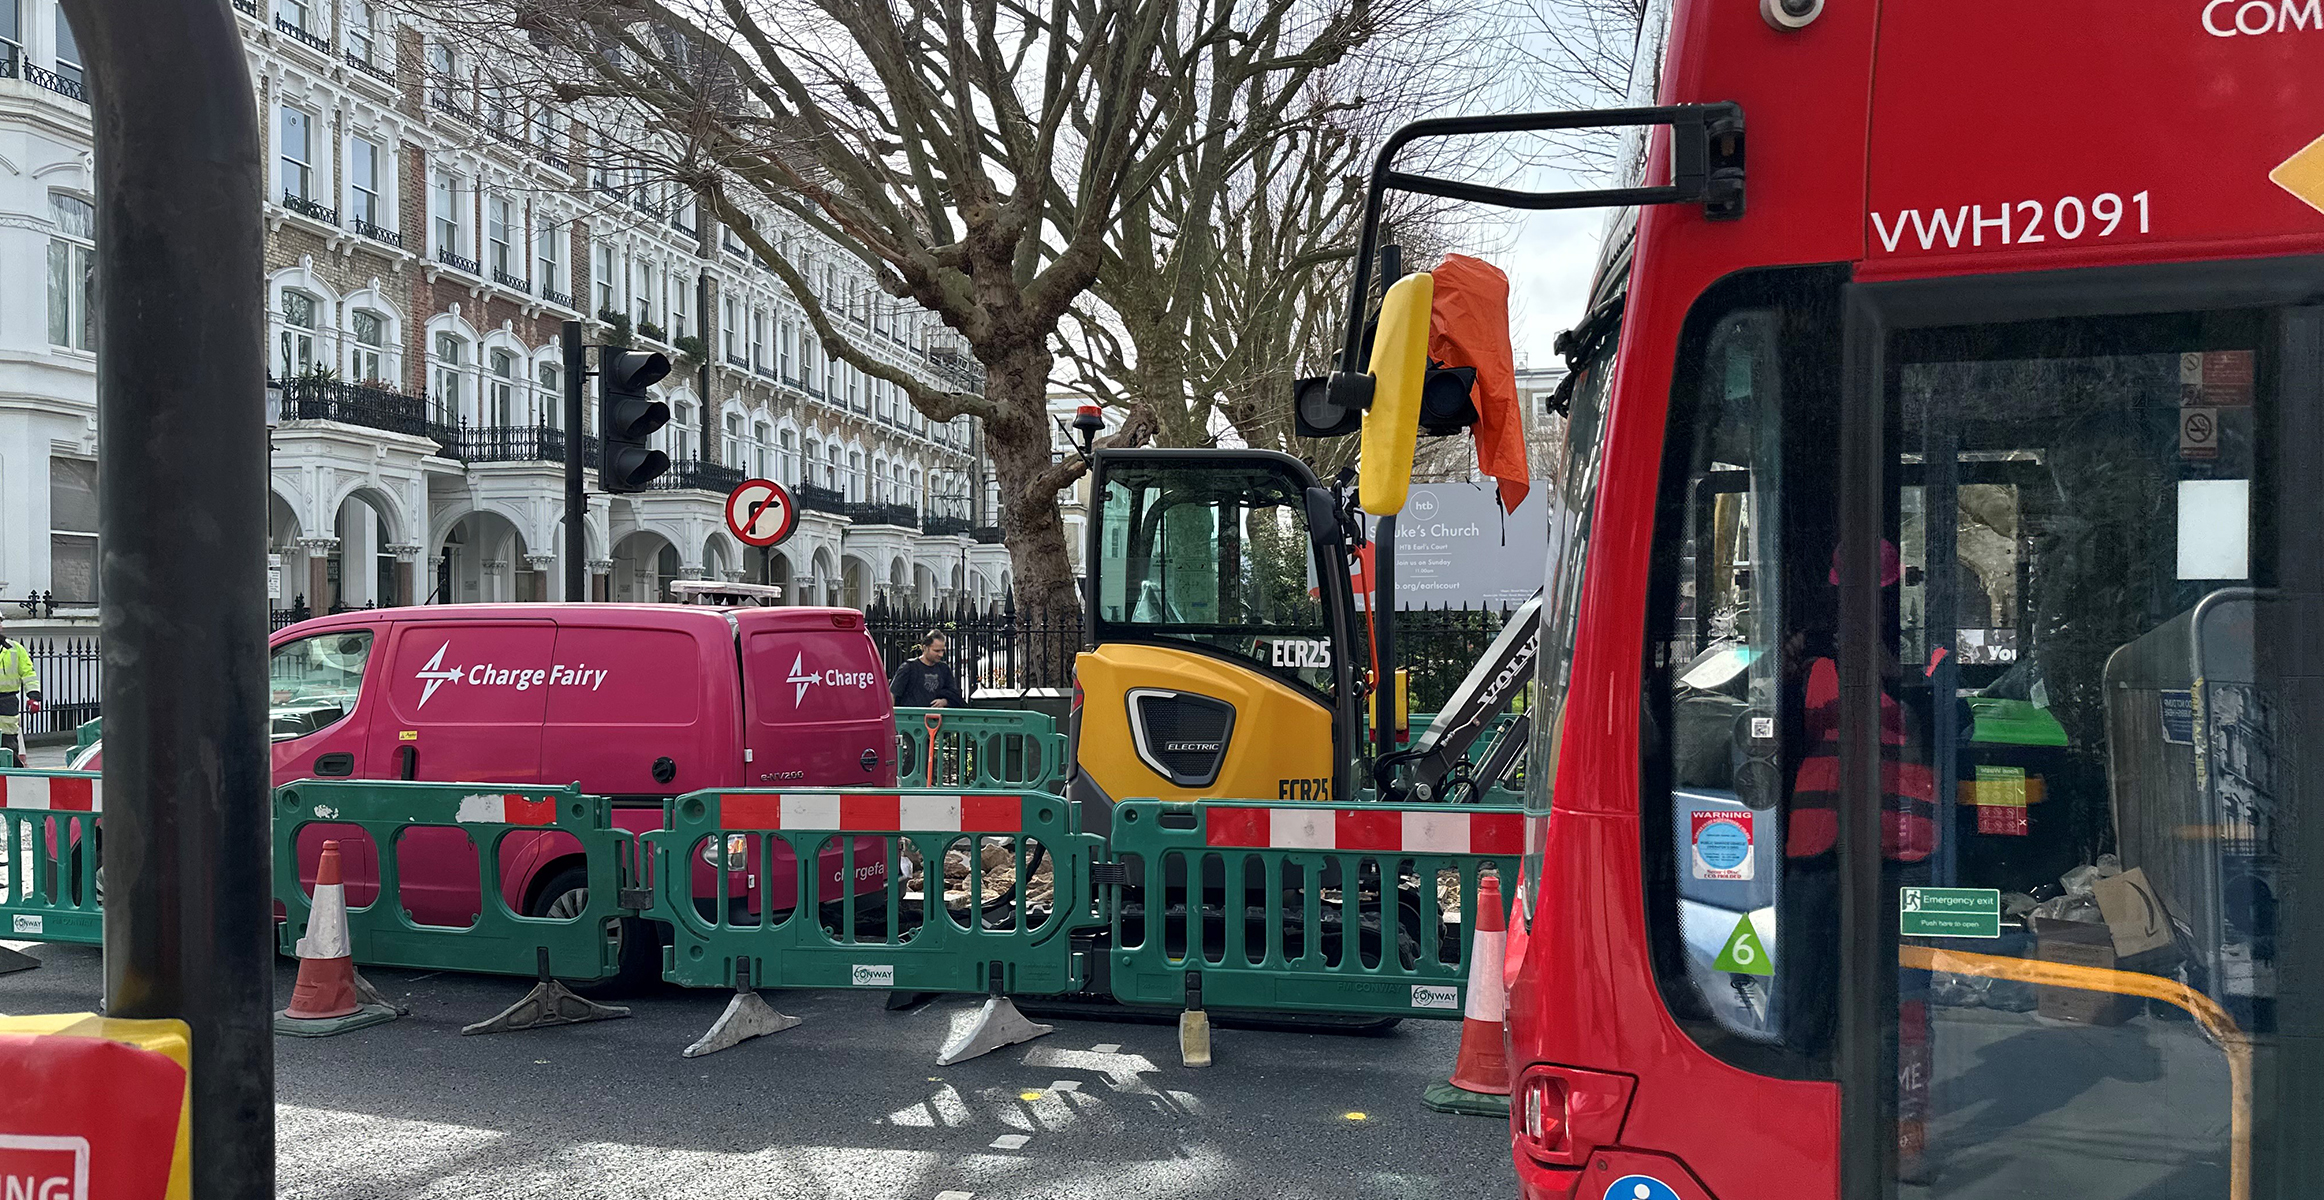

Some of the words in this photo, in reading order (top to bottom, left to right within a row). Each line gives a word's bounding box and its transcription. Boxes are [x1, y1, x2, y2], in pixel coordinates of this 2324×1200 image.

[1870, 189, 2149, 252] VWH2091
[1415, 500, 1433, 511] htb
[1394, 524, 1426, 538] uke's
[1430, 522, 1480, 537] Church
[1428, 559, 1451, 567] Sunday
[1395, 581, 1460, 592] b.org/earlscourt
[1272, 636, 1331, 668] ECR25
[468, 663, 546, 691] Charge
[549, 663, 608, 691] Fairy
[825, 669, 874, 689] Charge
[1167, 743, 1219, 751] ELECTRIC
[760, 770, 804, 781] e-NV200
[1279, 778, 1328, 800] ECR25
[1692, 811, 1752, 819] WARNING
[834, 861, 884, 882] crgefa
[1923, 895, 1975, 906] Emergency
[1976, 896, 1994, 905] exit
[1732, 933, 1755, 965] 6
[853, 969, 893, 979] CONWAY
[1413, 990, 1457, 1001] CONWAY
[0, 1174, 70, 1200] NG
